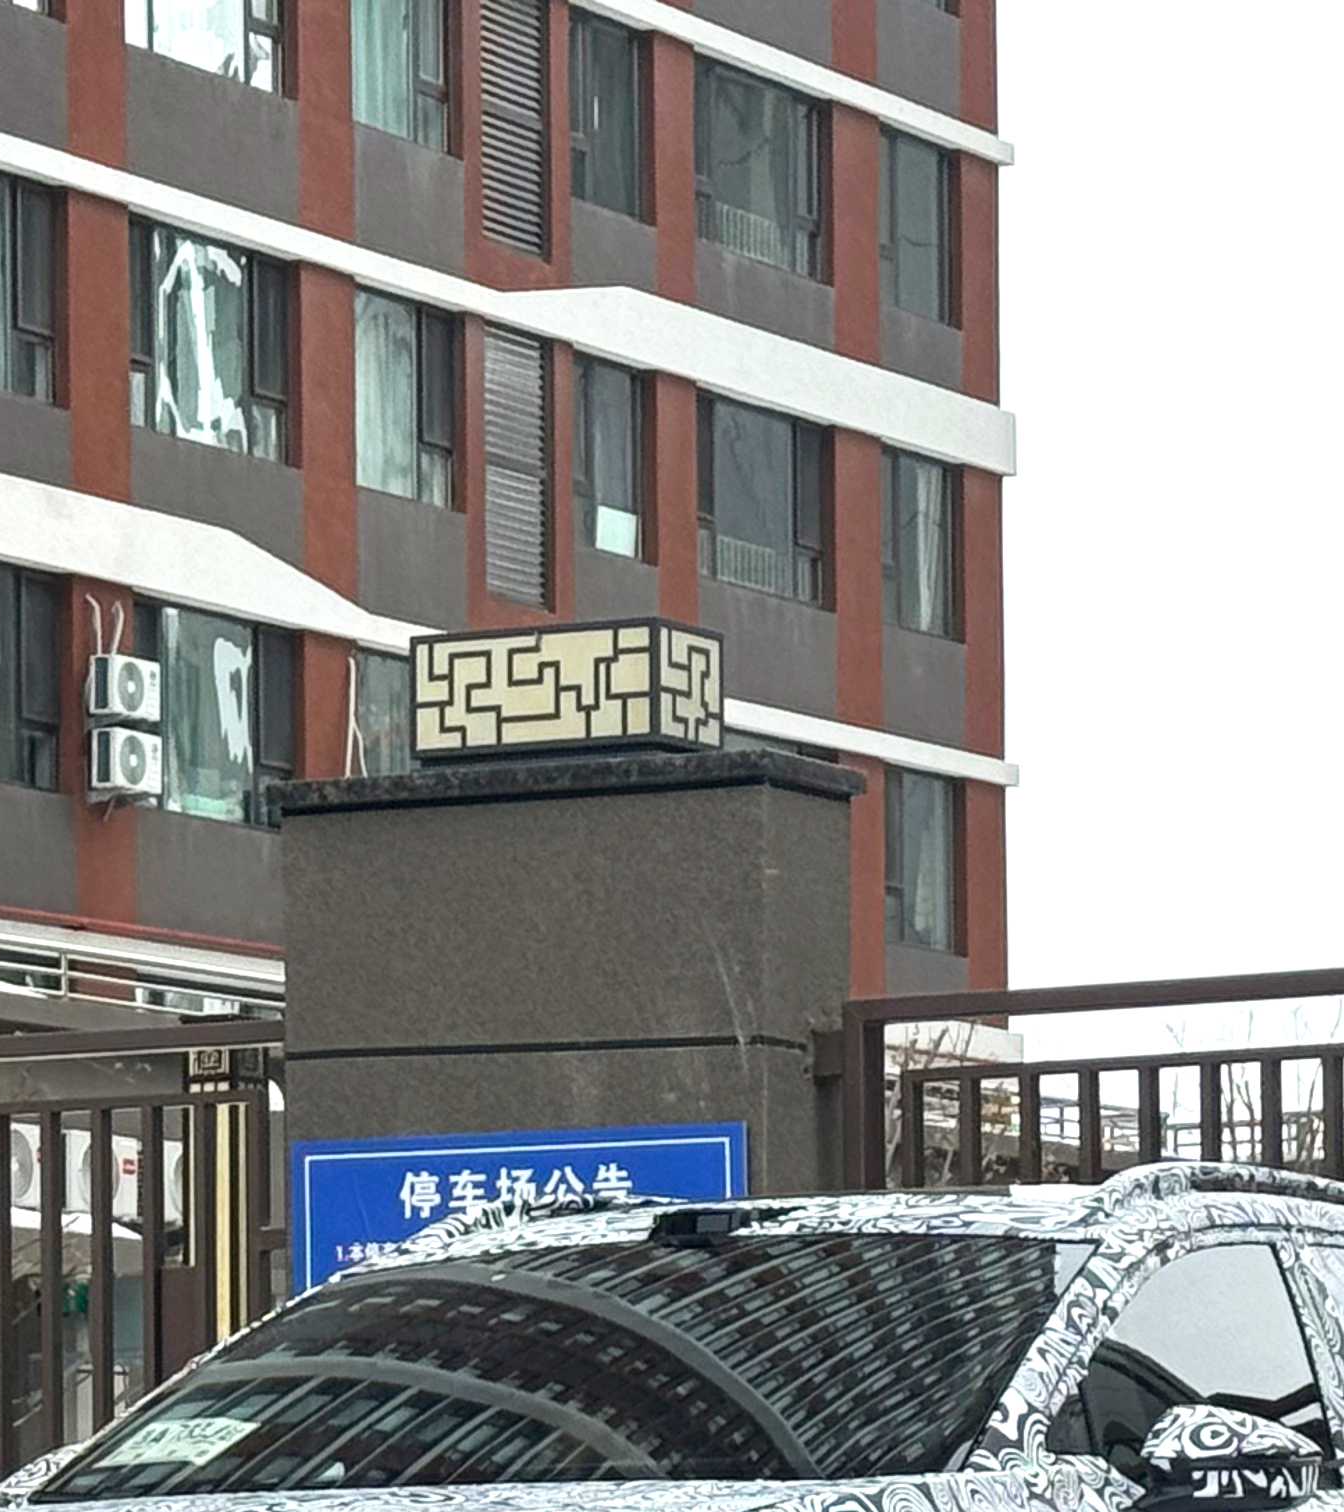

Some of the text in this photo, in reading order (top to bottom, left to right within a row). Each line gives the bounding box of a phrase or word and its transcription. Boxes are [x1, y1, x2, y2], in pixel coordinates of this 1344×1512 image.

[399, 1162, 634, 1219] 停车场公告
